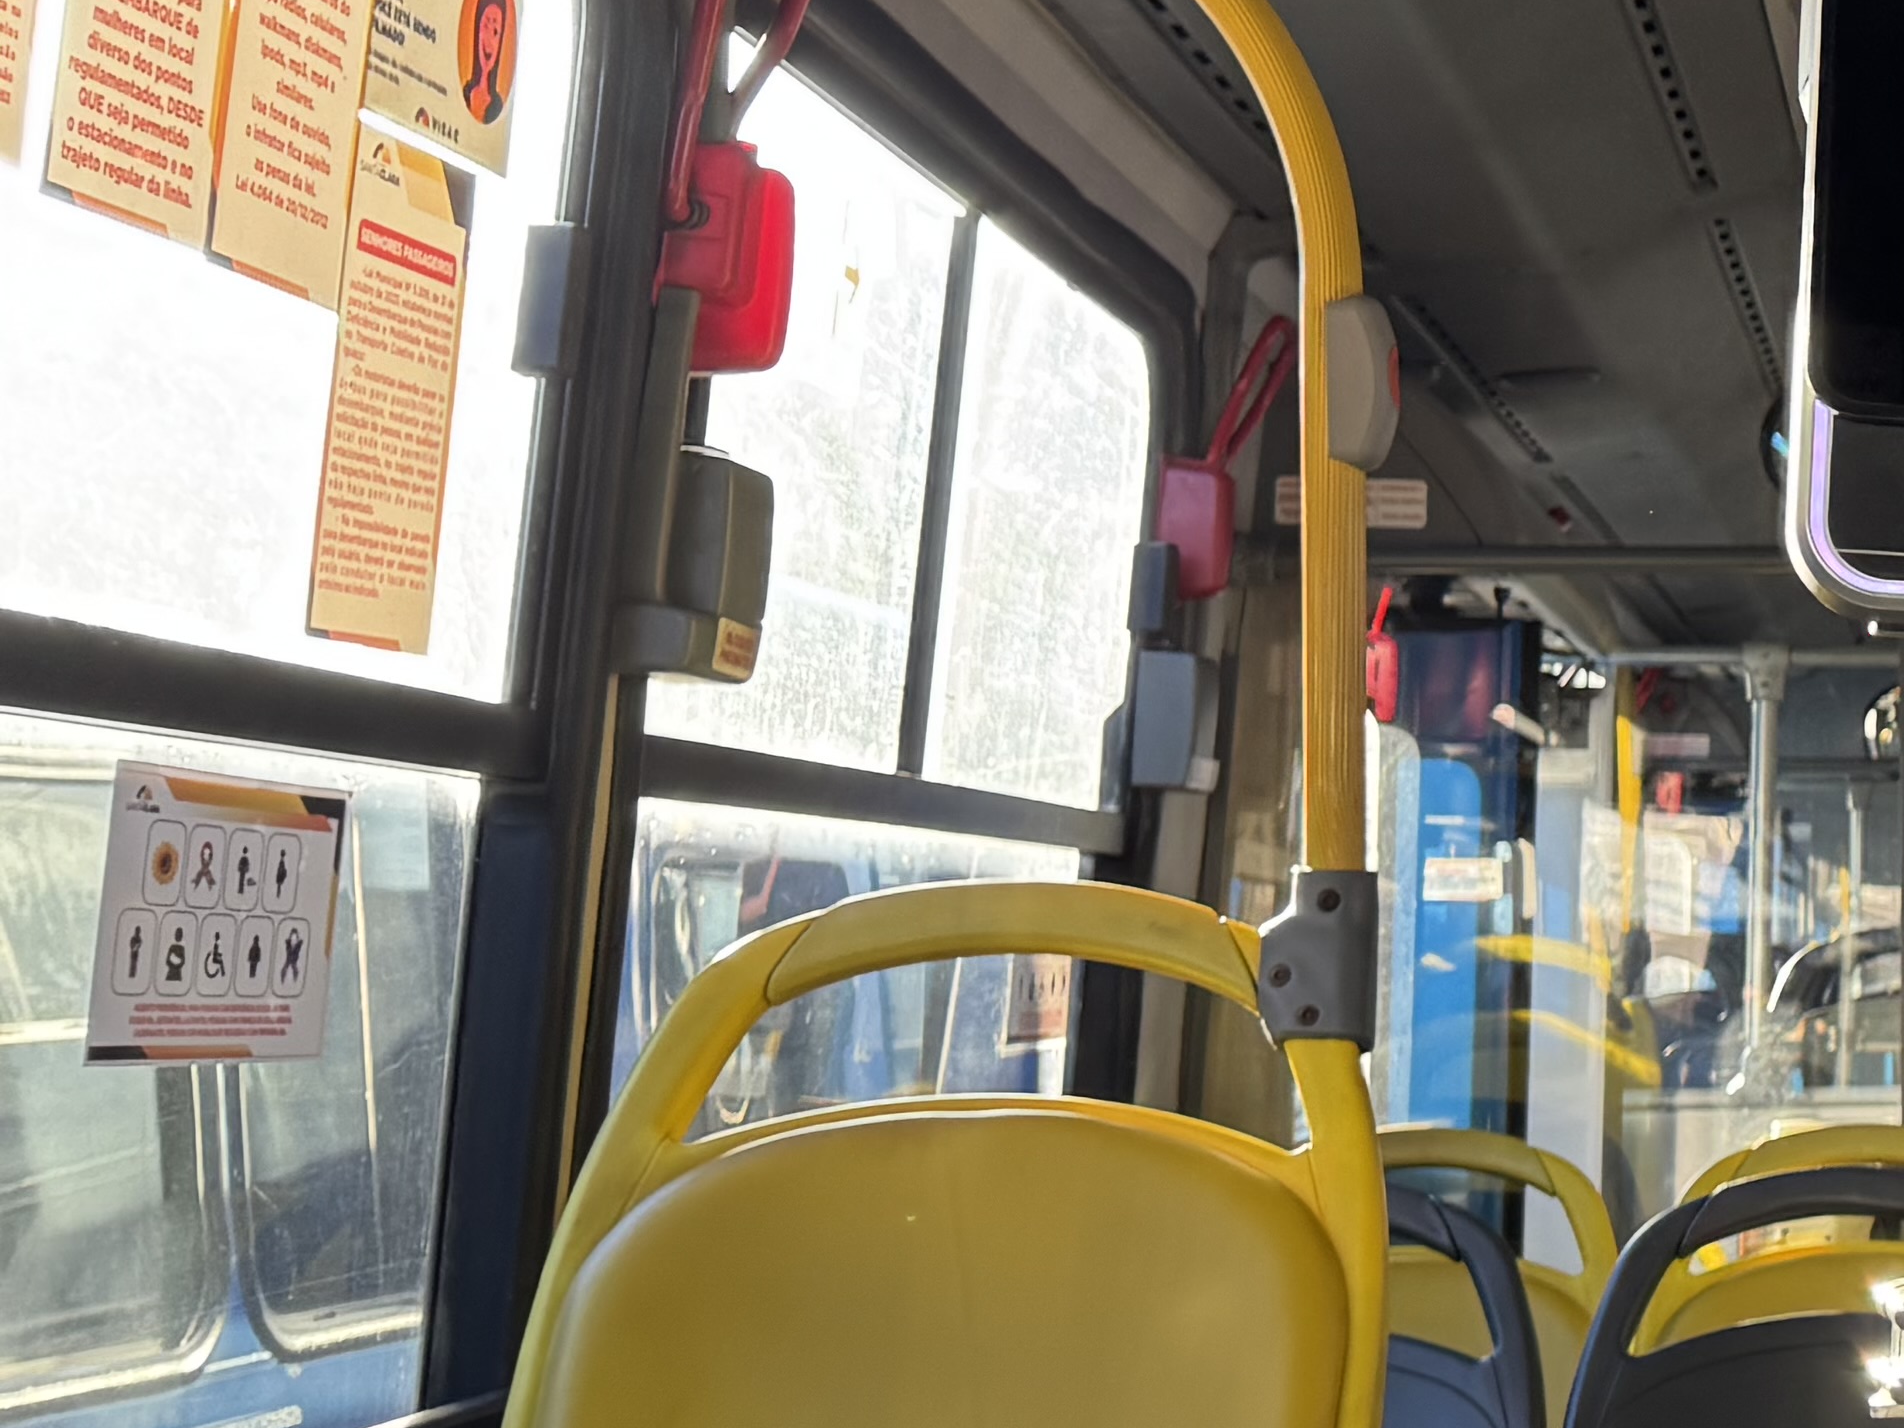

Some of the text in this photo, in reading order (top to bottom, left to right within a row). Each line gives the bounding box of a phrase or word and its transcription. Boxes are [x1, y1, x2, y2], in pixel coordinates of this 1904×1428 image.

[93, 6, 195, 66] mulheres em local
[184, 17, 199, 39] de
[87, 30, 193, 94] diverso dos pontos
[78, 86, 104, 114] QUE
[106, 102, 129, 125] seja
[166, 96, 204, 127] DESDE
[60, 140, 101, 172] trajeto
[102, 161, 145, 189] regular
[146, 174, 161, 197] da
[77, 121, 168, 169] estacionamento
[178, 162, 193, 180] no
